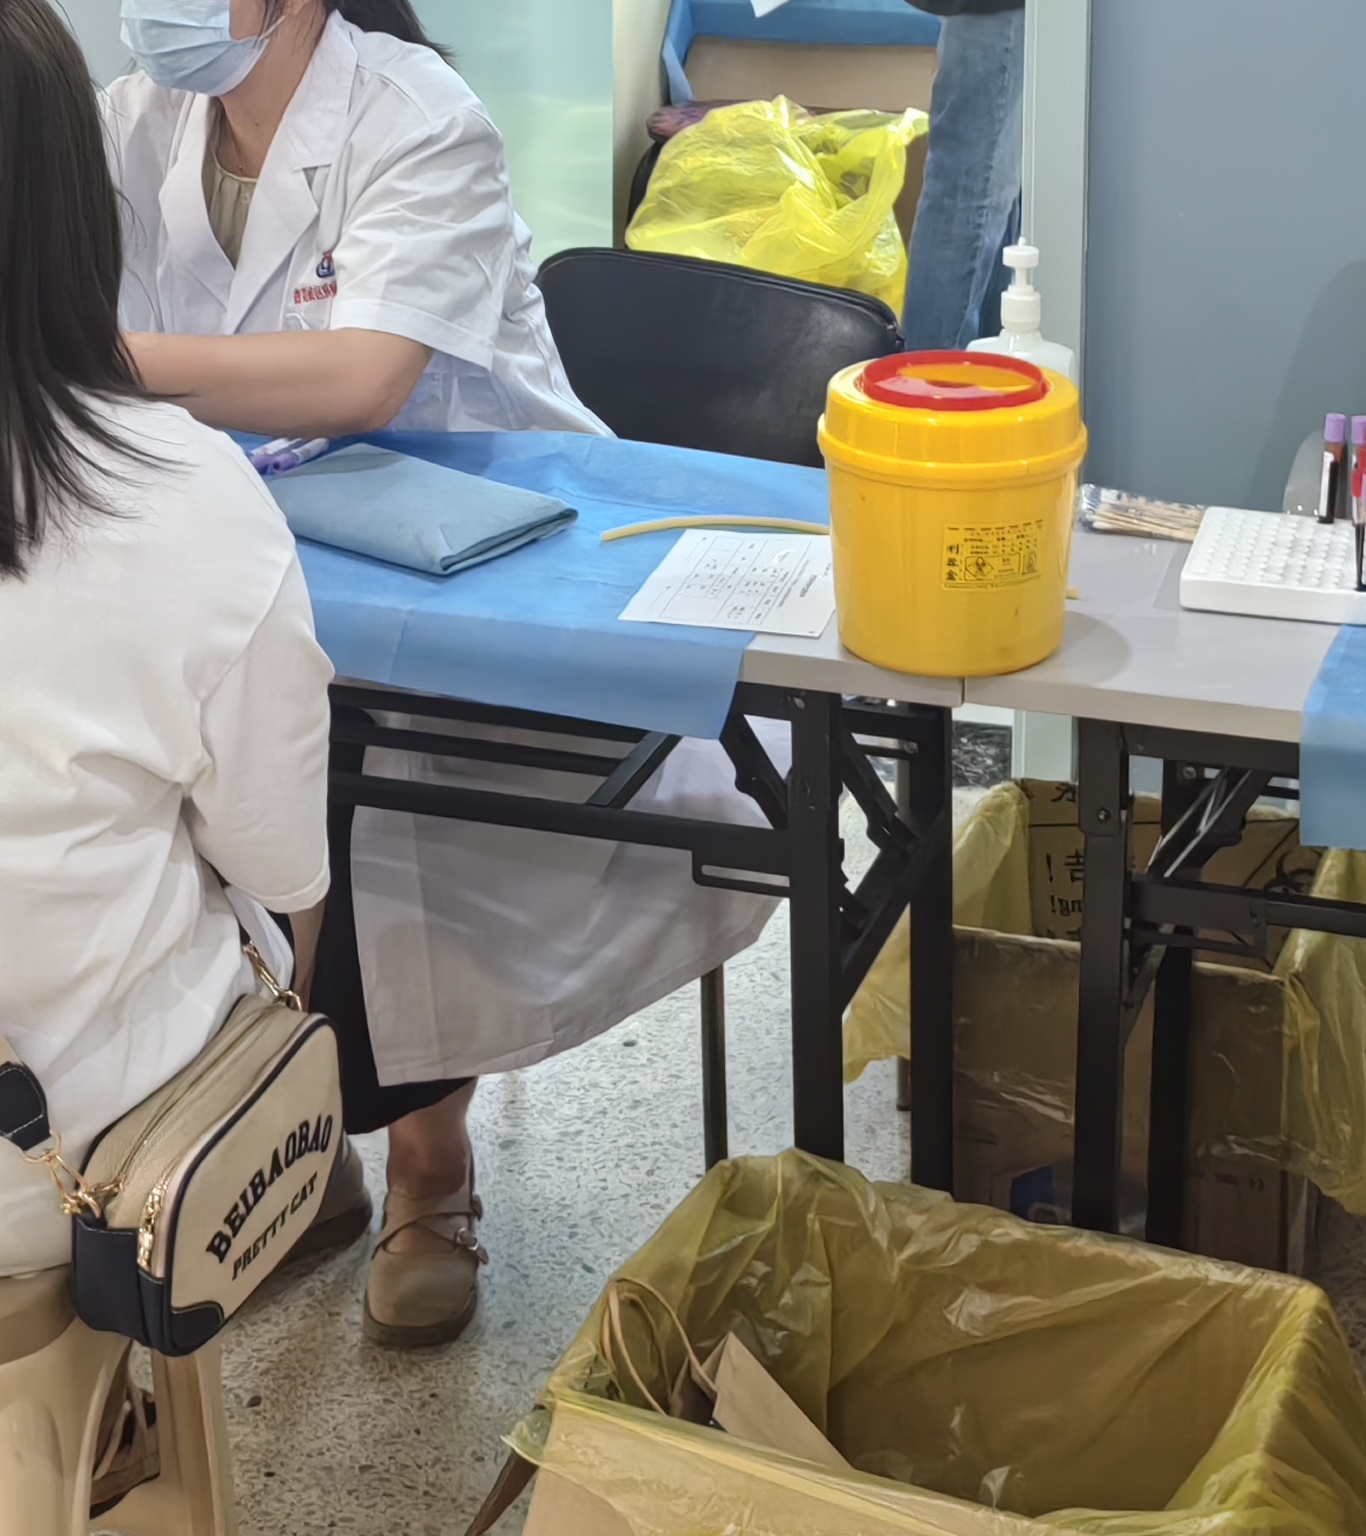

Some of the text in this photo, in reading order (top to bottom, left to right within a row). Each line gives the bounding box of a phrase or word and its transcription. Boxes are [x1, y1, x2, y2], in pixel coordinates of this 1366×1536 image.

[205, 1114, 333, 1264] BEIBAOBAO
[231, 1170, 318, 1282] PRETTY CAT
